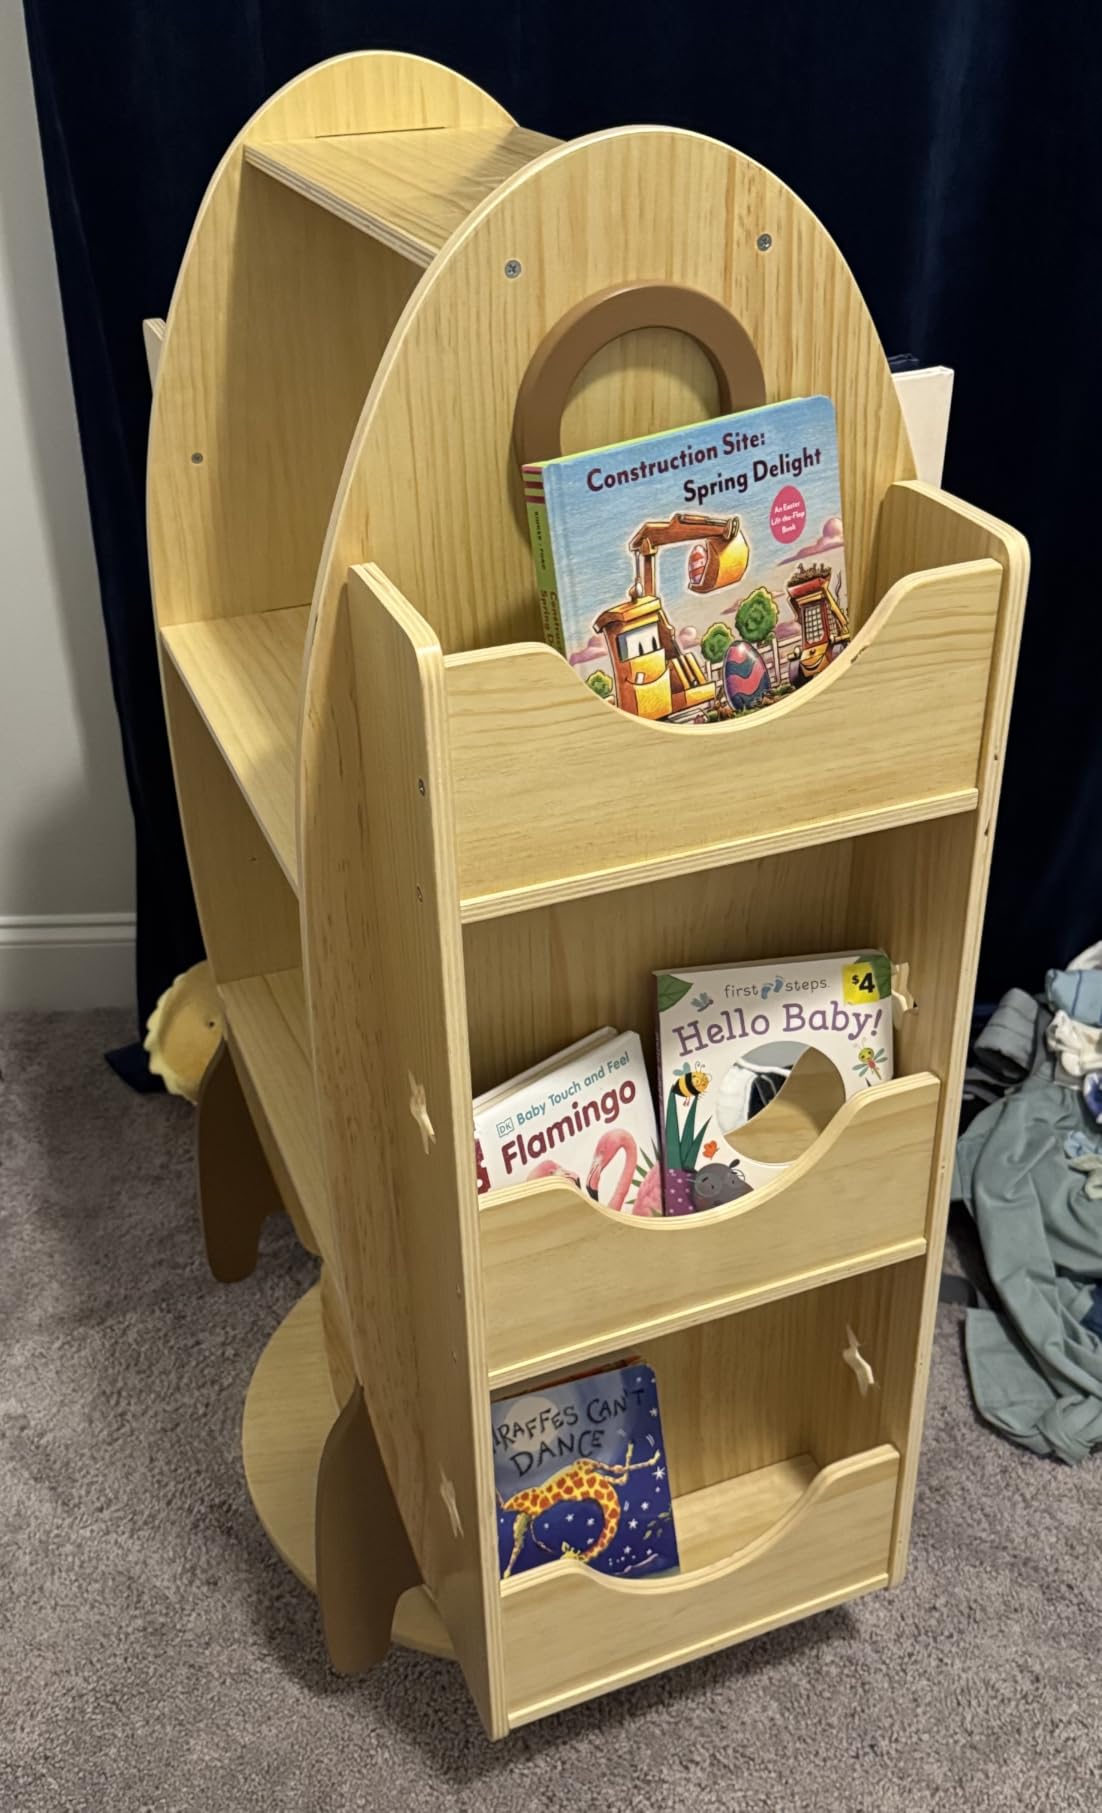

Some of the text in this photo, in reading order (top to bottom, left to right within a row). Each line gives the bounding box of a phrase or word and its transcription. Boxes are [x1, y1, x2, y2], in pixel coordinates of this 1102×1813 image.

[586, 432, 766, 493] Construction Site:
[683, 446, 822, 505] Spring Delight
[724, 984, 759, 999] first
[851, 972, 876, 993] $4
[672, 1000, 883, 1057] Hello Baby!
[498, 1051, 631, 1135] DK Baby Touch and Feel
[501, 1080, 637, 1175] Flamingo
[492, 1388, 645, 1456] IRAFFES CAN'T
[509, 1430, 605, 1478] DANCE
